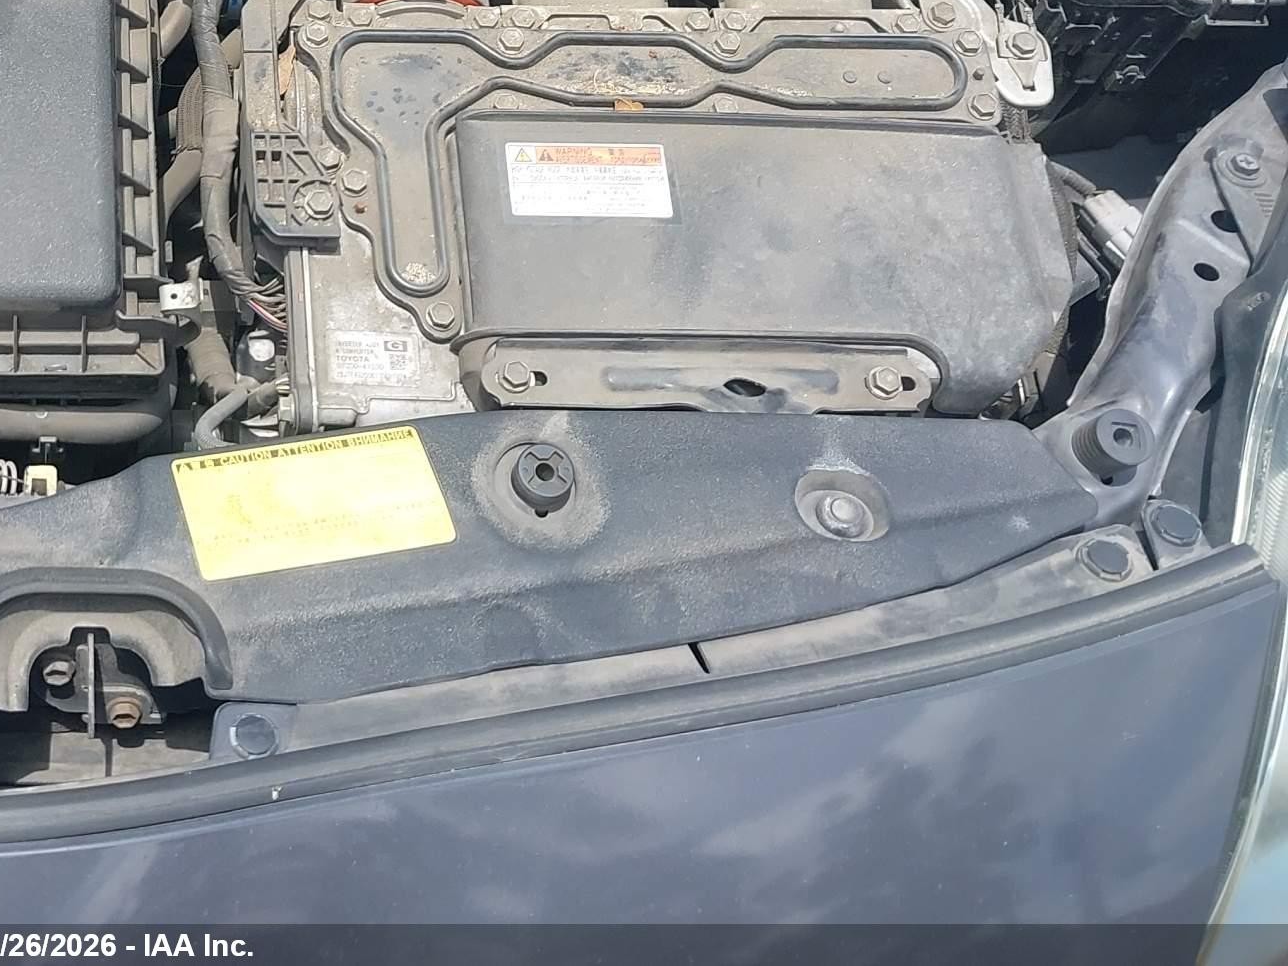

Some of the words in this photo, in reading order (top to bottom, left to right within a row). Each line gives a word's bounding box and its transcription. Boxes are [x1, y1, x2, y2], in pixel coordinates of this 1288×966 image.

[347, 430, 413, 448] ВНИМАНИЕ
[220, 450, 272, 466] CAUTION
[277, 440, 343, 458] ATTENTION
